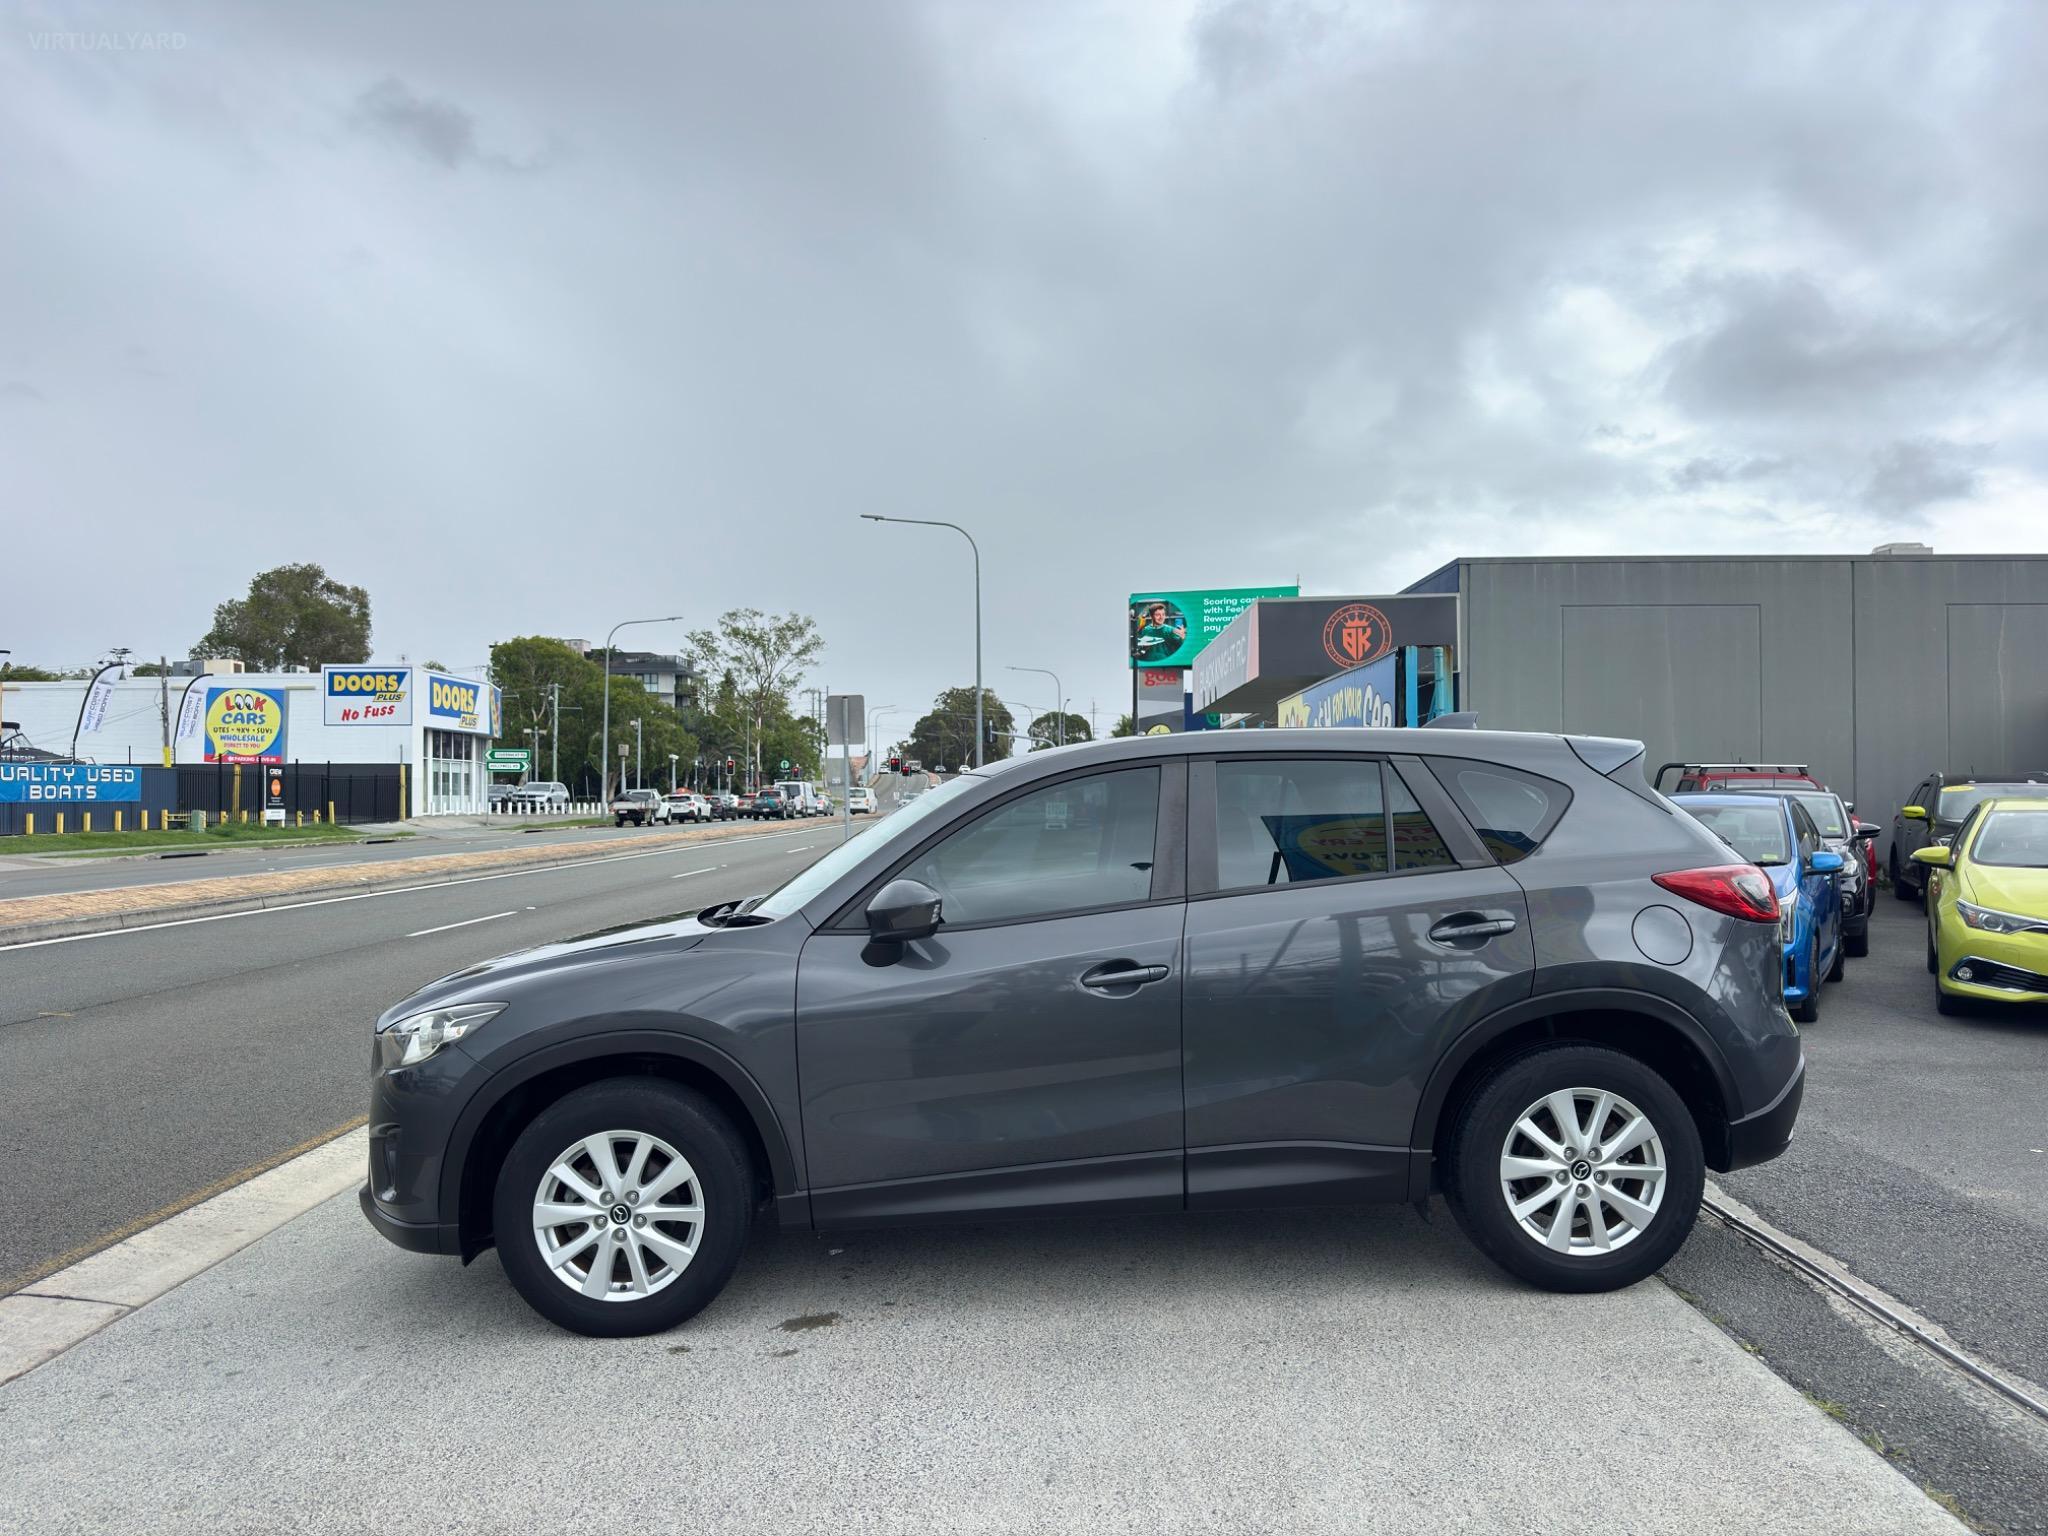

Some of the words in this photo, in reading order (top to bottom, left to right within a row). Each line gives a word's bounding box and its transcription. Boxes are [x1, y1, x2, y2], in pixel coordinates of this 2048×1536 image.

[1203, 605, 1223, 614] with
[1226, 605, 1244, 613] Feel
[333, 675, 399, 692] DOORS
[224, 693, 268, 712] LOOK
[433, 682, 474, 713] DOORS
[1332, 689, 1344, 724] FOR
[1344, 687, 1362, 718] YOUR
[221, 712, 267, 725] CARS
[341, 708, 360, 721] No
[364, 705, 396, 719] Fuss
[461, 717, 478, 727] PLUS
[220, 734, 266, 742] WHOLESALE
[1, 766, 76, 782] UALITY
[87, 768, 135, 782] USED
[29, 784, 98, 799] BOATS
